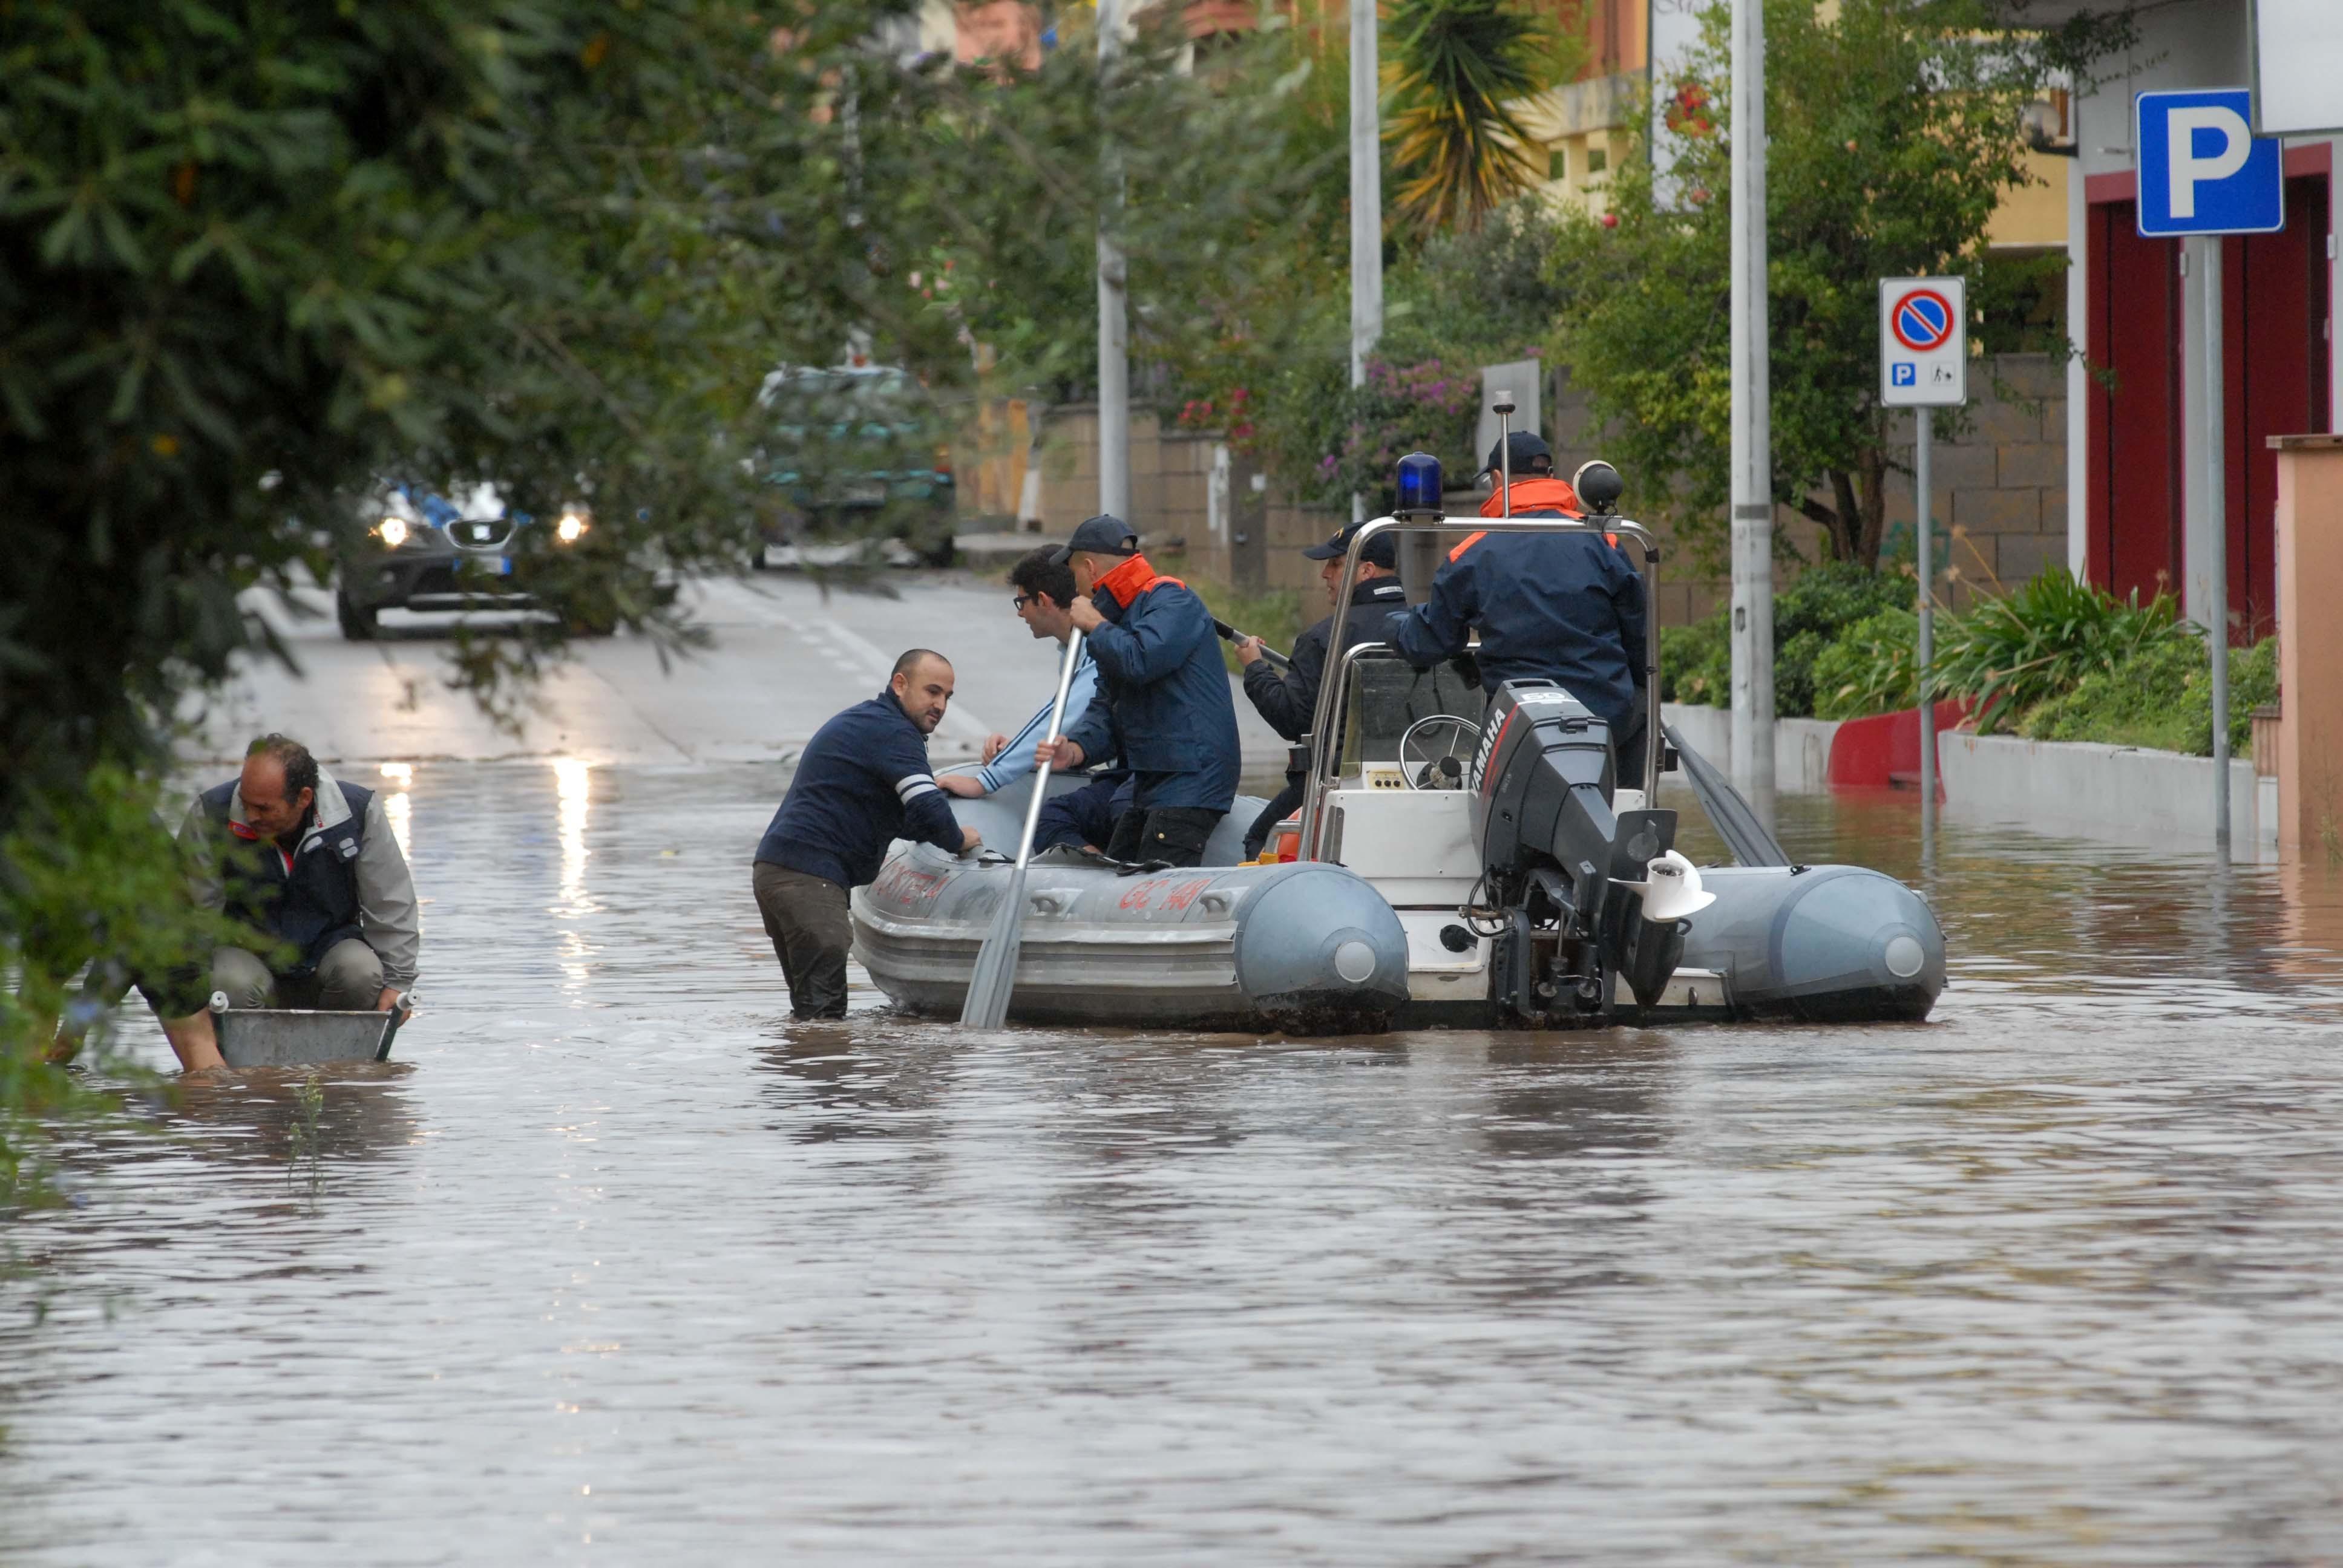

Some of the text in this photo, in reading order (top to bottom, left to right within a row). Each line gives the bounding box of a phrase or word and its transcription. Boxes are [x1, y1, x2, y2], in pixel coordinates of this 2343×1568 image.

[2168, 106, 2252, 218] P
[1896, 365, 1912, 385] P
[1470, 708, 1506, 799] YAMAHA
